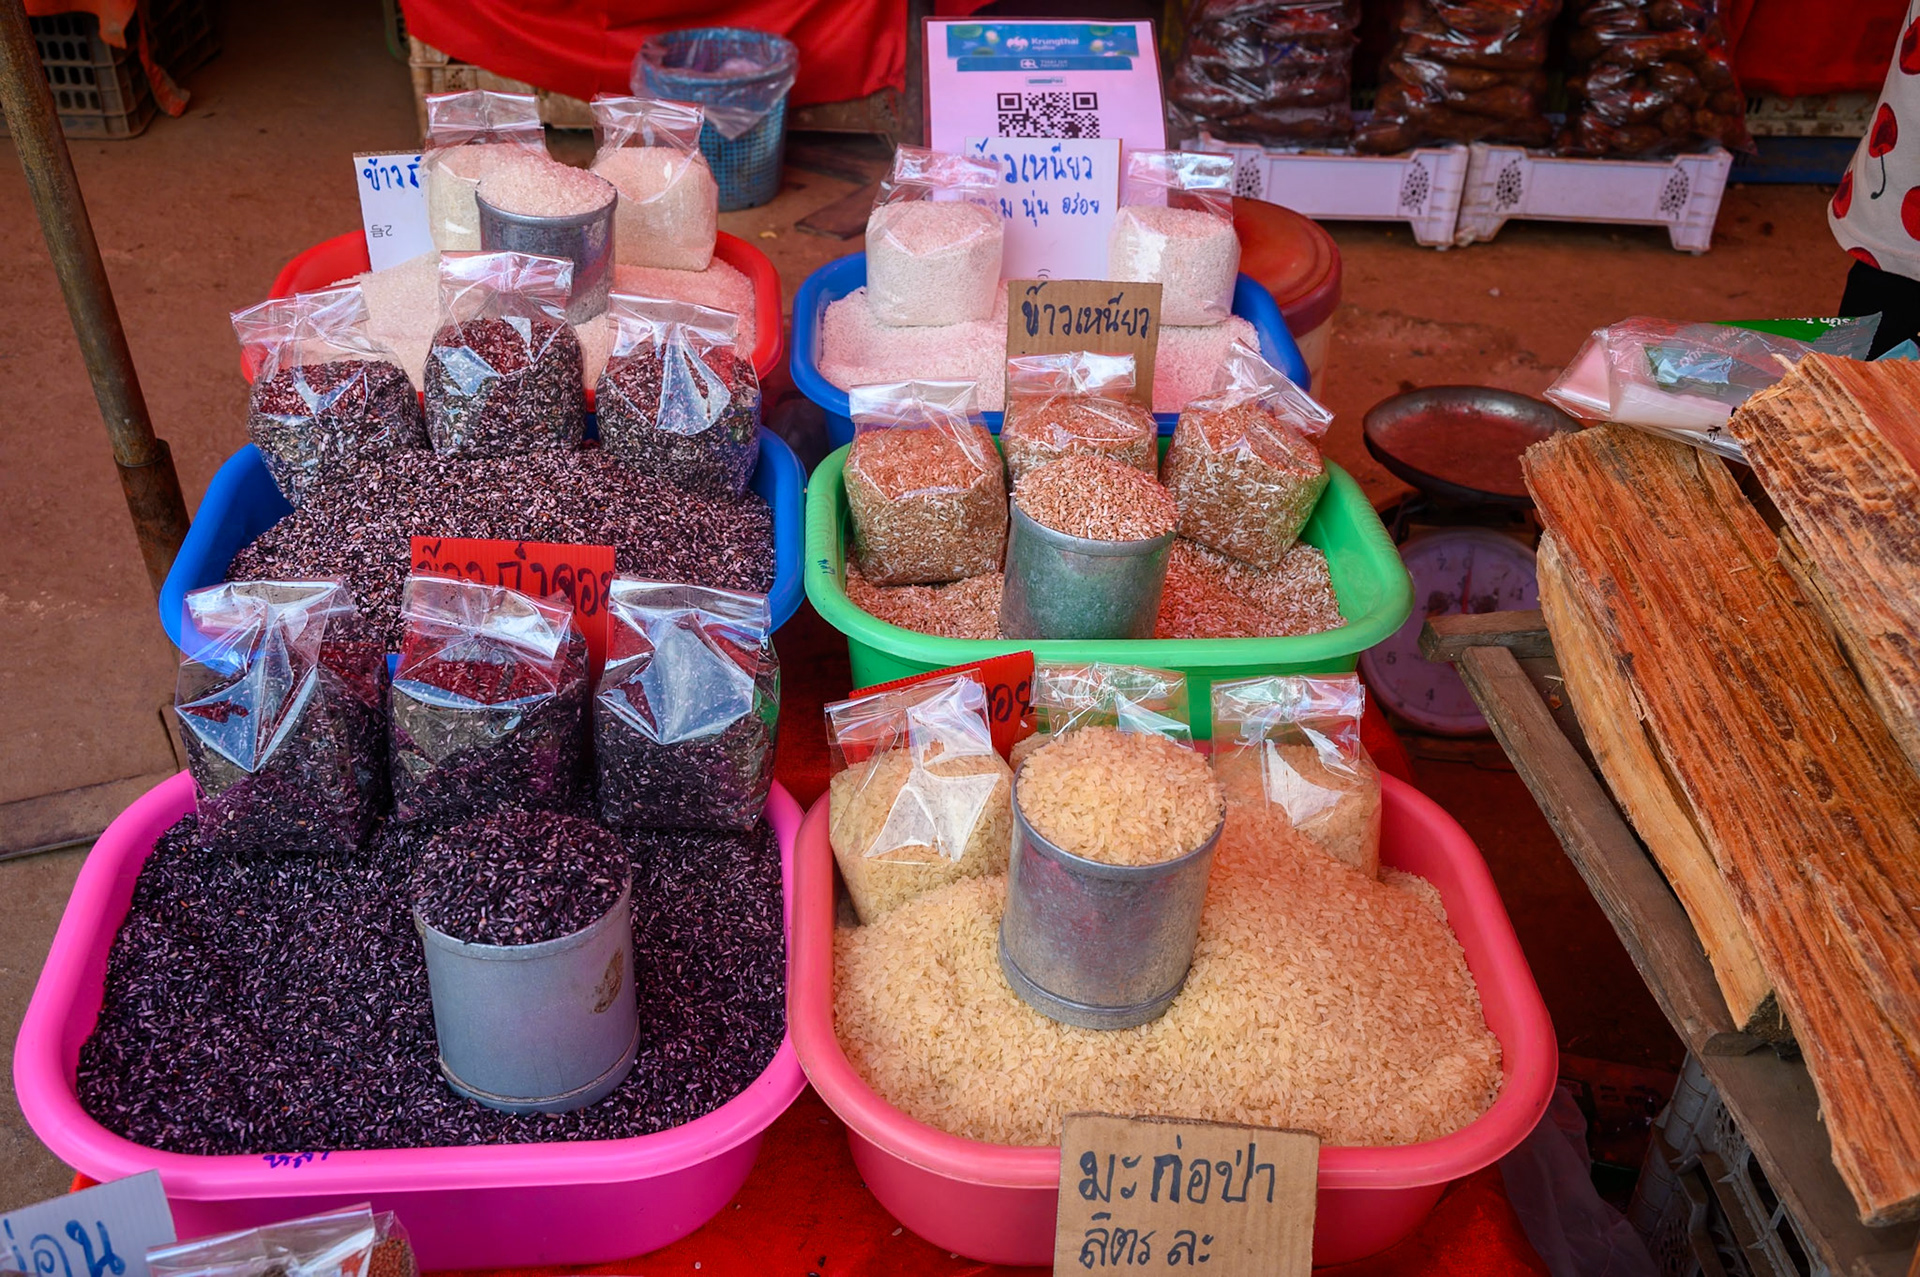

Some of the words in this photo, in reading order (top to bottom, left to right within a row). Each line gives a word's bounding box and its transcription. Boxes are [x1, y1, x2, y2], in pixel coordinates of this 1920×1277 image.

[1031, 37, 1079, 46] Krungthai
[1021, 282, 1150, 338] ข้าวเหนียว
[1386, 652, 1397, 665] 5
[1079, 1212, 1157, 1269] ลิตร
[1167, 1229, 1214, 1267] ละ
